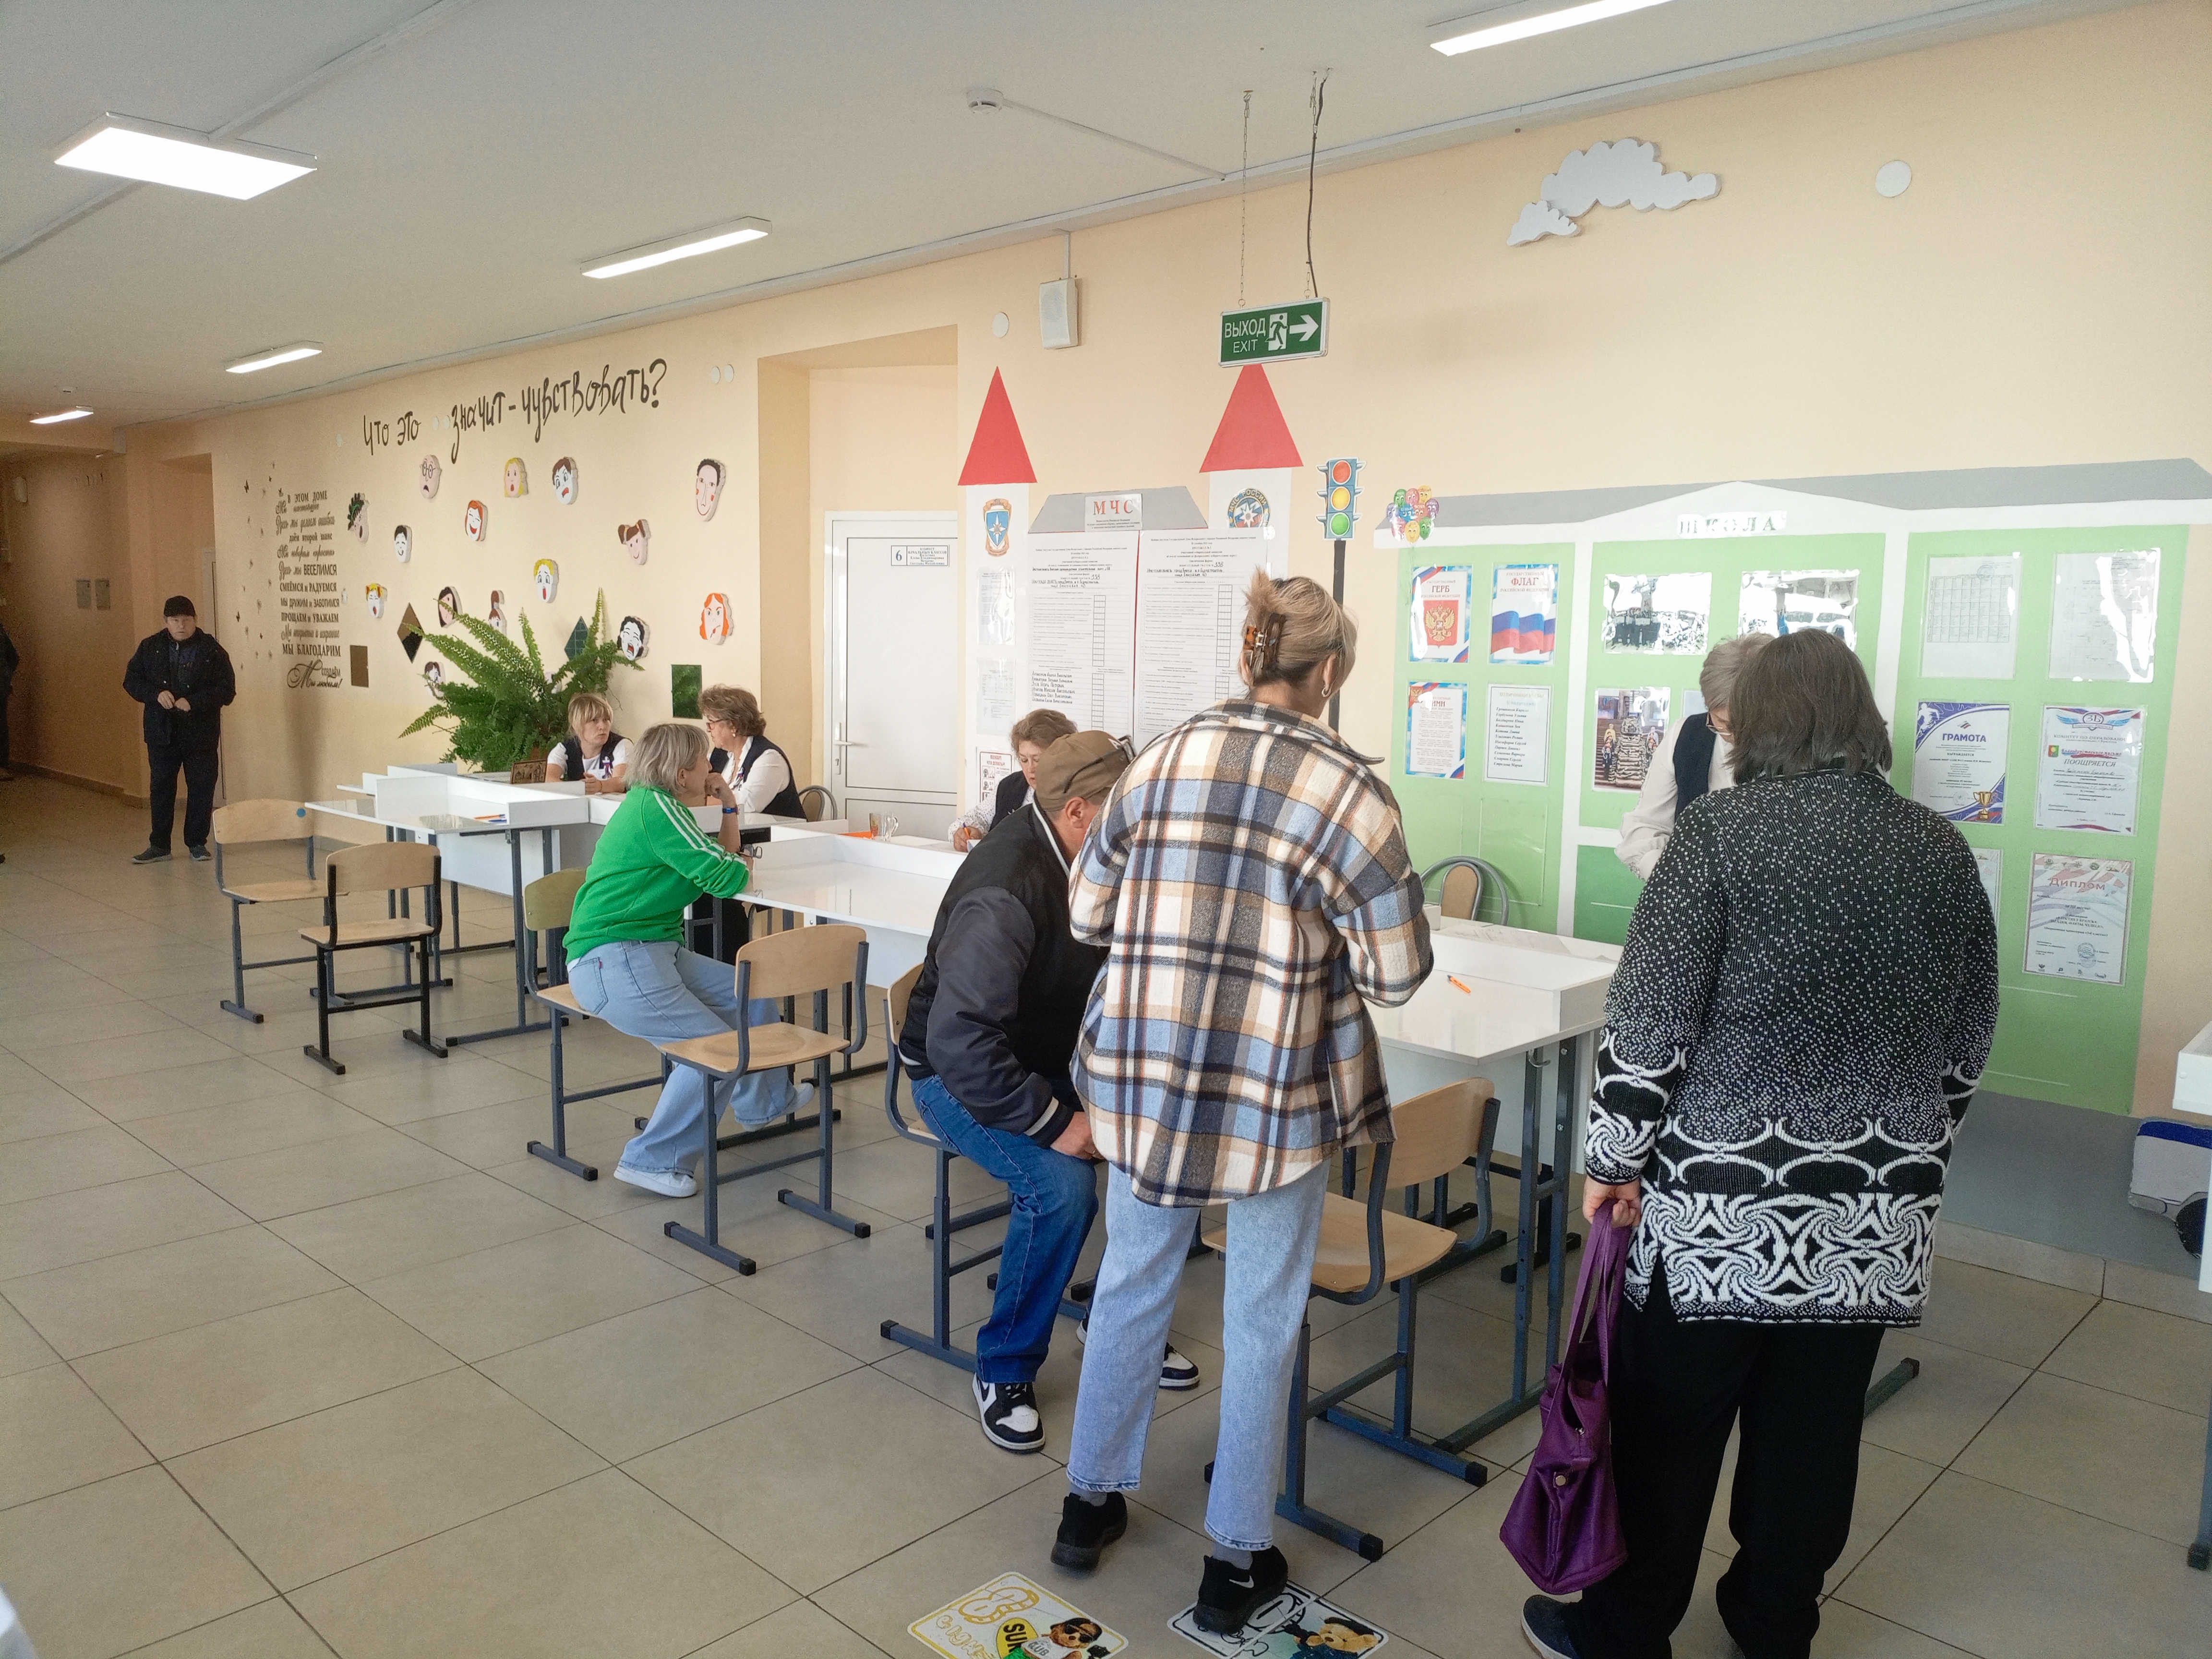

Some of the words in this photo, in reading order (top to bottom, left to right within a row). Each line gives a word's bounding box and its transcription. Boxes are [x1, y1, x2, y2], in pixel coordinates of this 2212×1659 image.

[1225, 317, 1266, 338] ВЫХОД
[1233, 339, 1258, 353] EXIT
[397, 411, 421, 445] это
[295, 493, 309, 503] ЭТОМ
[313, 490, 327, 502] ДОМЕ
[1229, 496, 1239, 512] МЧС
[1242, 489, 1267, 505] РОССИИ
[1094, 499, 1133, 515] МЧС
[896, 550, 902, 561] 6
[303, 564, 337, 576] ВЕСЕЛИМСЯ
[1511, 577, 1539, 586] ФЛАГ
[309, 582, 337, 594] РАДУЕМСЯ
[281, 612, 306, 624] ПРОЩАЕМ
[313, 613, 338, 623] УВАЖАЕМ
[282, 643, 294, 655] МЫ
[297, 644, 341, 658] БЛАГОДАРИМ
[1942, 733, 1986, 742] ГРАМОТА
[2064, 759, 2116, 767] ПООЩРЯЕТСЯ
